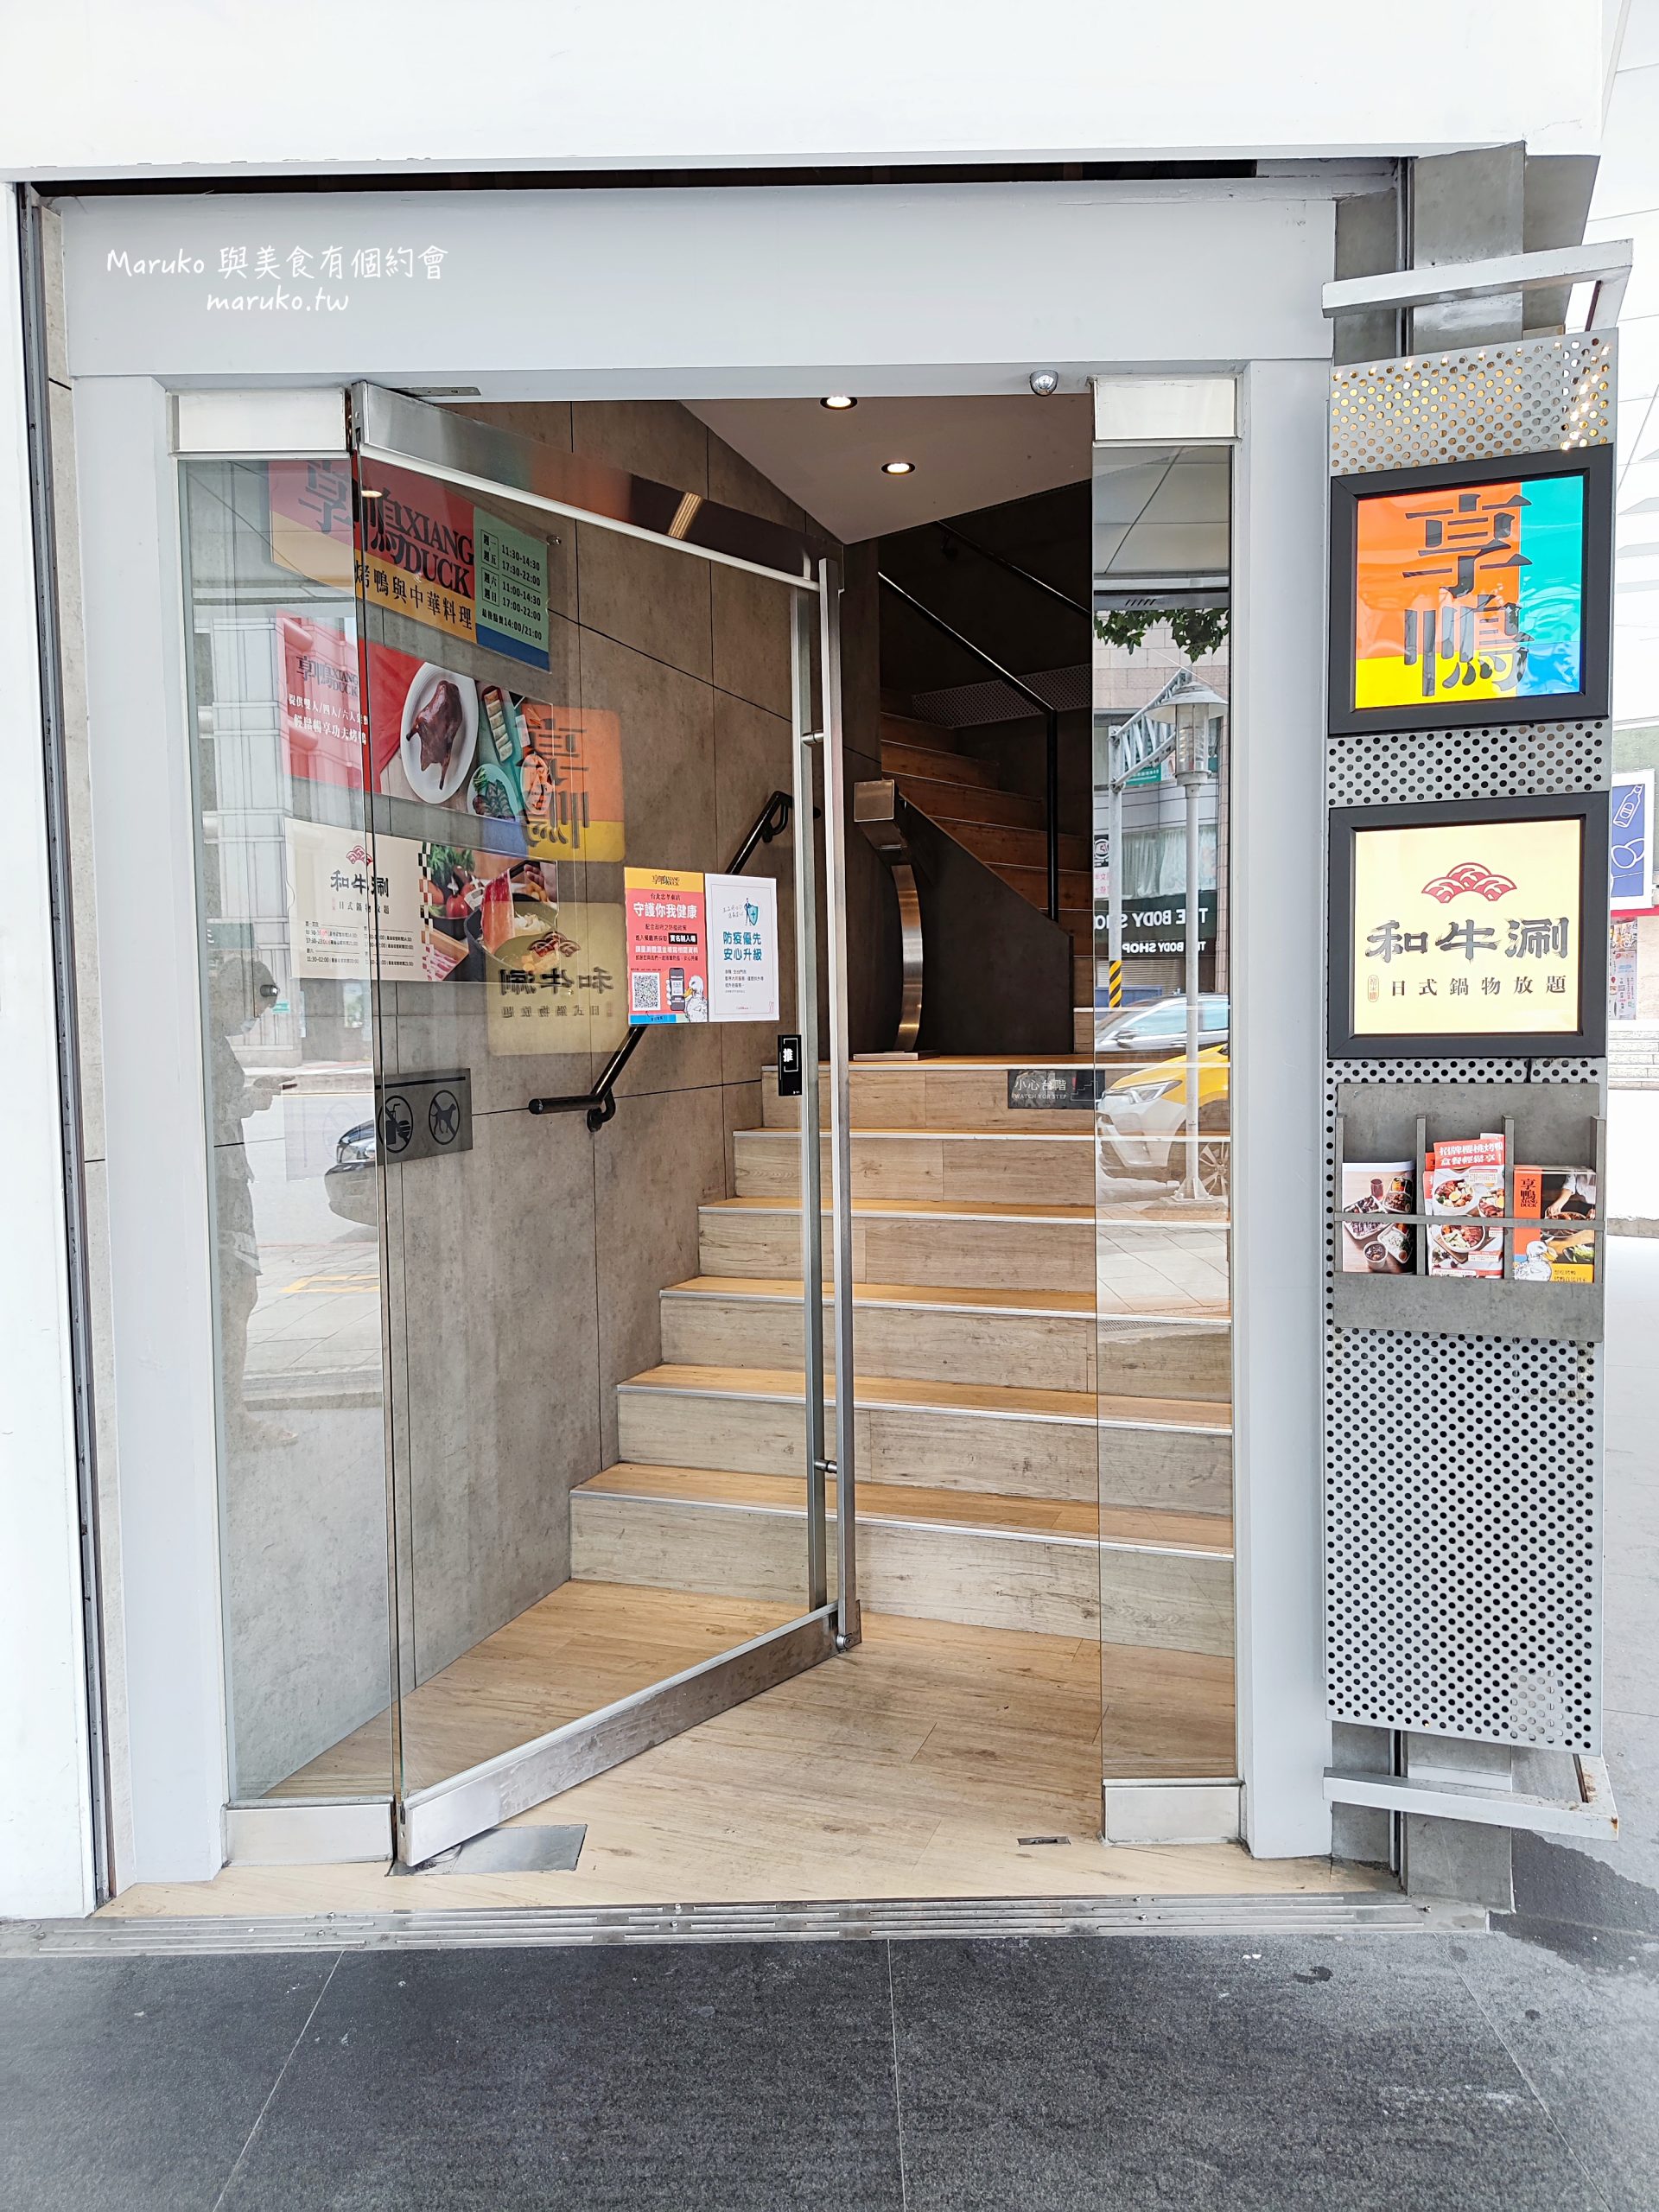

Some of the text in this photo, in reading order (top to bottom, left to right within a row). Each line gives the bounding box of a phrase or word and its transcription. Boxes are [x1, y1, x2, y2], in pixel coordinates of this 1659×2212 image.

[403, 505, 474, 566] XIANG
[403, 541, 472, 599] DUCK
[501, 544, 540, 571] 11:30-14:30
[502, 560, 541, 587] 17:30-22:00
[354, 559, 473, 631] 烤鴨與中華料理
[502, 581, 541, 607] 11:00-14:30
[1402, 493, 1535, 696] 享鴨
[502, 596, 541, 622] 17:00-22:00
[333, 680, 359, 698] DUCK
[330, 869, 389, 898] 和牛涮
[633, 901, 697, 919] 守護你我健康
[723, 931, 761, 945] 防疫優先
[1365, 917, 1569, 963] 和牛涮
[723, 947, 762, 961] 安心升級
[1391, 975, 1567, 996] 日式鍋物放題
[1014, 1079, 1067, 1091] 小心台階
